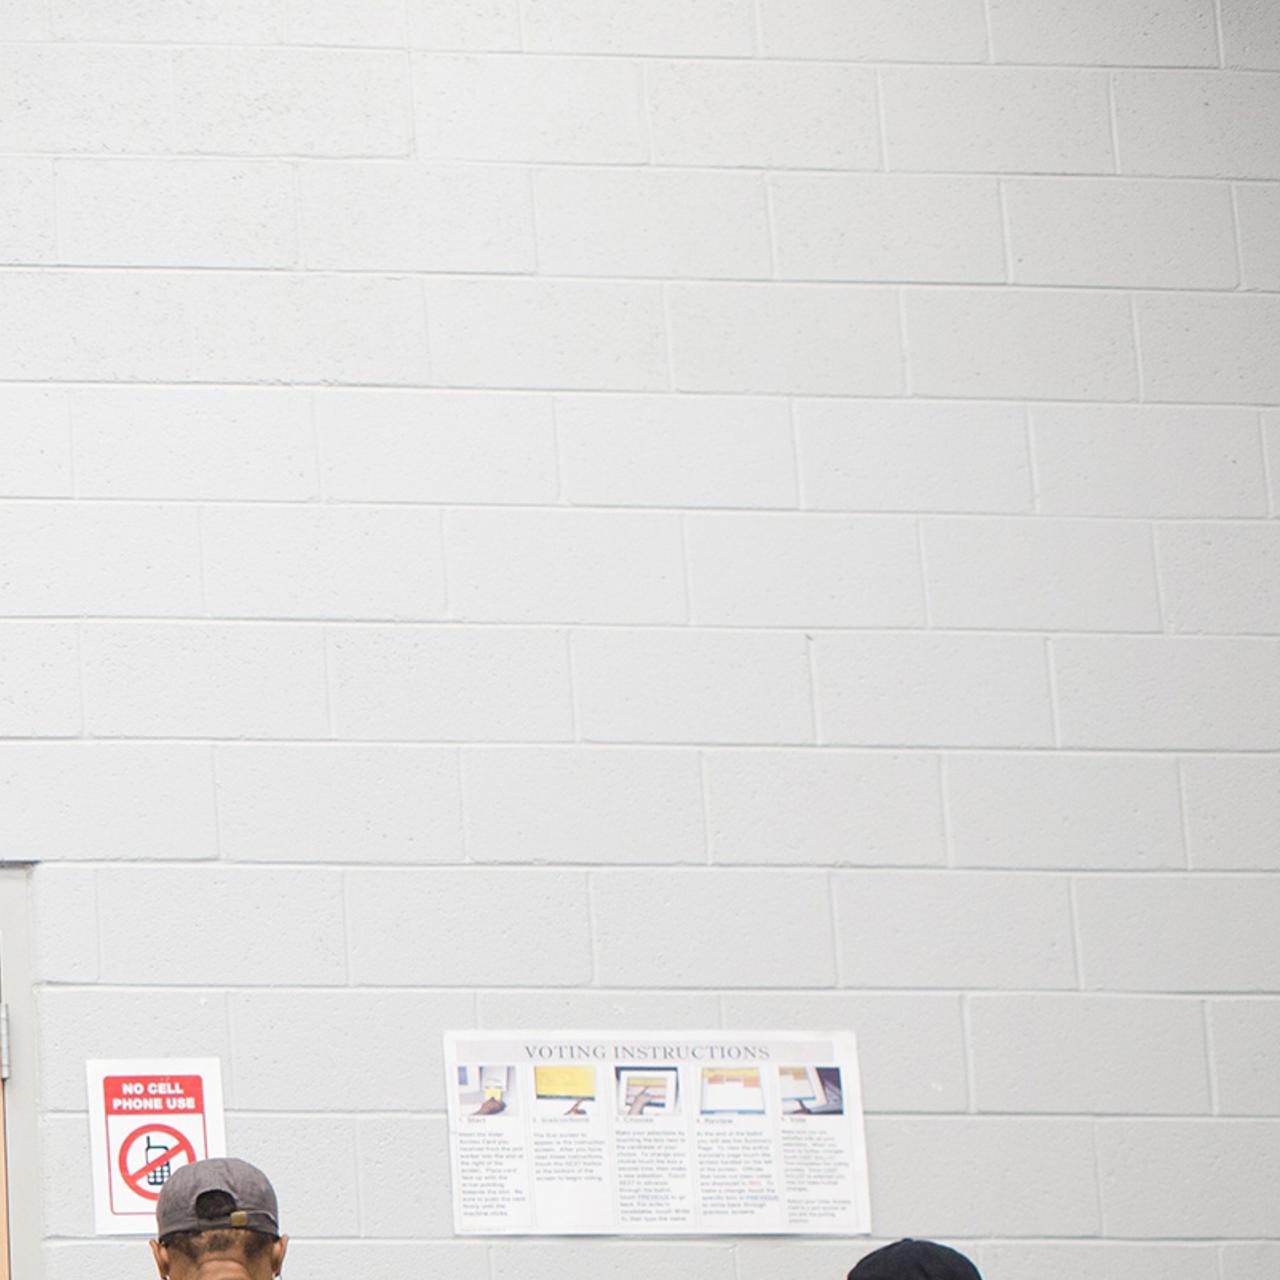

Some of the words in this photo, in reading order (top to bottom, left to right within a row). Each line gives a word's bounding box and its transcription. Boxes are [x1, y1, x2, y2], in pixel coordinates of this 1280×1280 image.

[524, 1045, 606, 1060] VOTING
[614, 1045, 771, 1060] INSTRUCTIONS
[122, 1083, 144, 1094] NO
[147, 1083, 184, 1094] CELL
[112, 1097, 163, 1110] PHONE
[166, 1097, 195, 1109] USE
